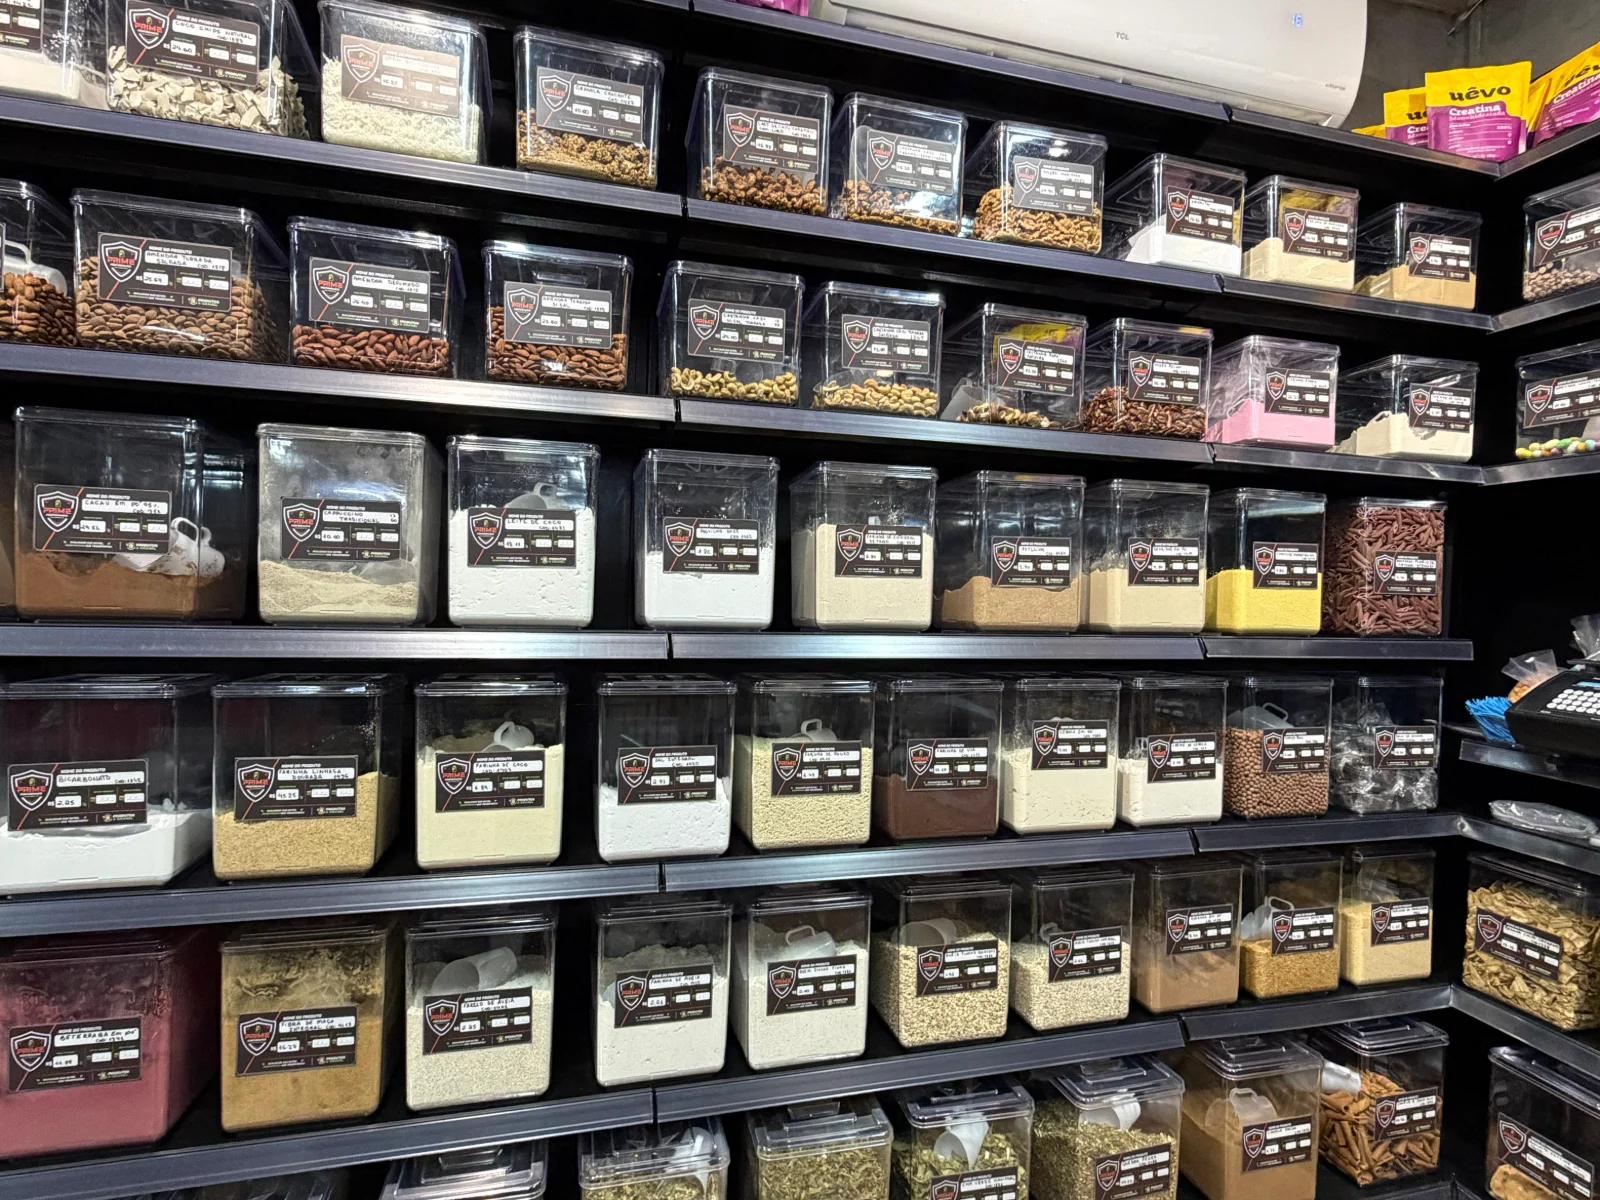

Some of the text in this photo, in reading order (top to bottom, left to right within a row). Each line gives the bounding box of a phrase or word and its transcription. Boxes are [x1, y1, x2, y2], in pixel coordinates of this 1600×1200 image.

[134, 22, 163, 33] PRIME
[1116, 32, 1130, 41] TCL
[544, 87, 566, 97] PRIME
[1450, 86, 1511, 101] uêvo
[1450, 105, 1501, 116] Creatina
[108, 256, 135, 266] PRIME
[318, 280, 343, 289] PRIME
[512, 302, 535, 310] PRIME
[59, 775, 111, 783] BICARBONATO
[60, 1032, 108, 1041] BETERRABA
